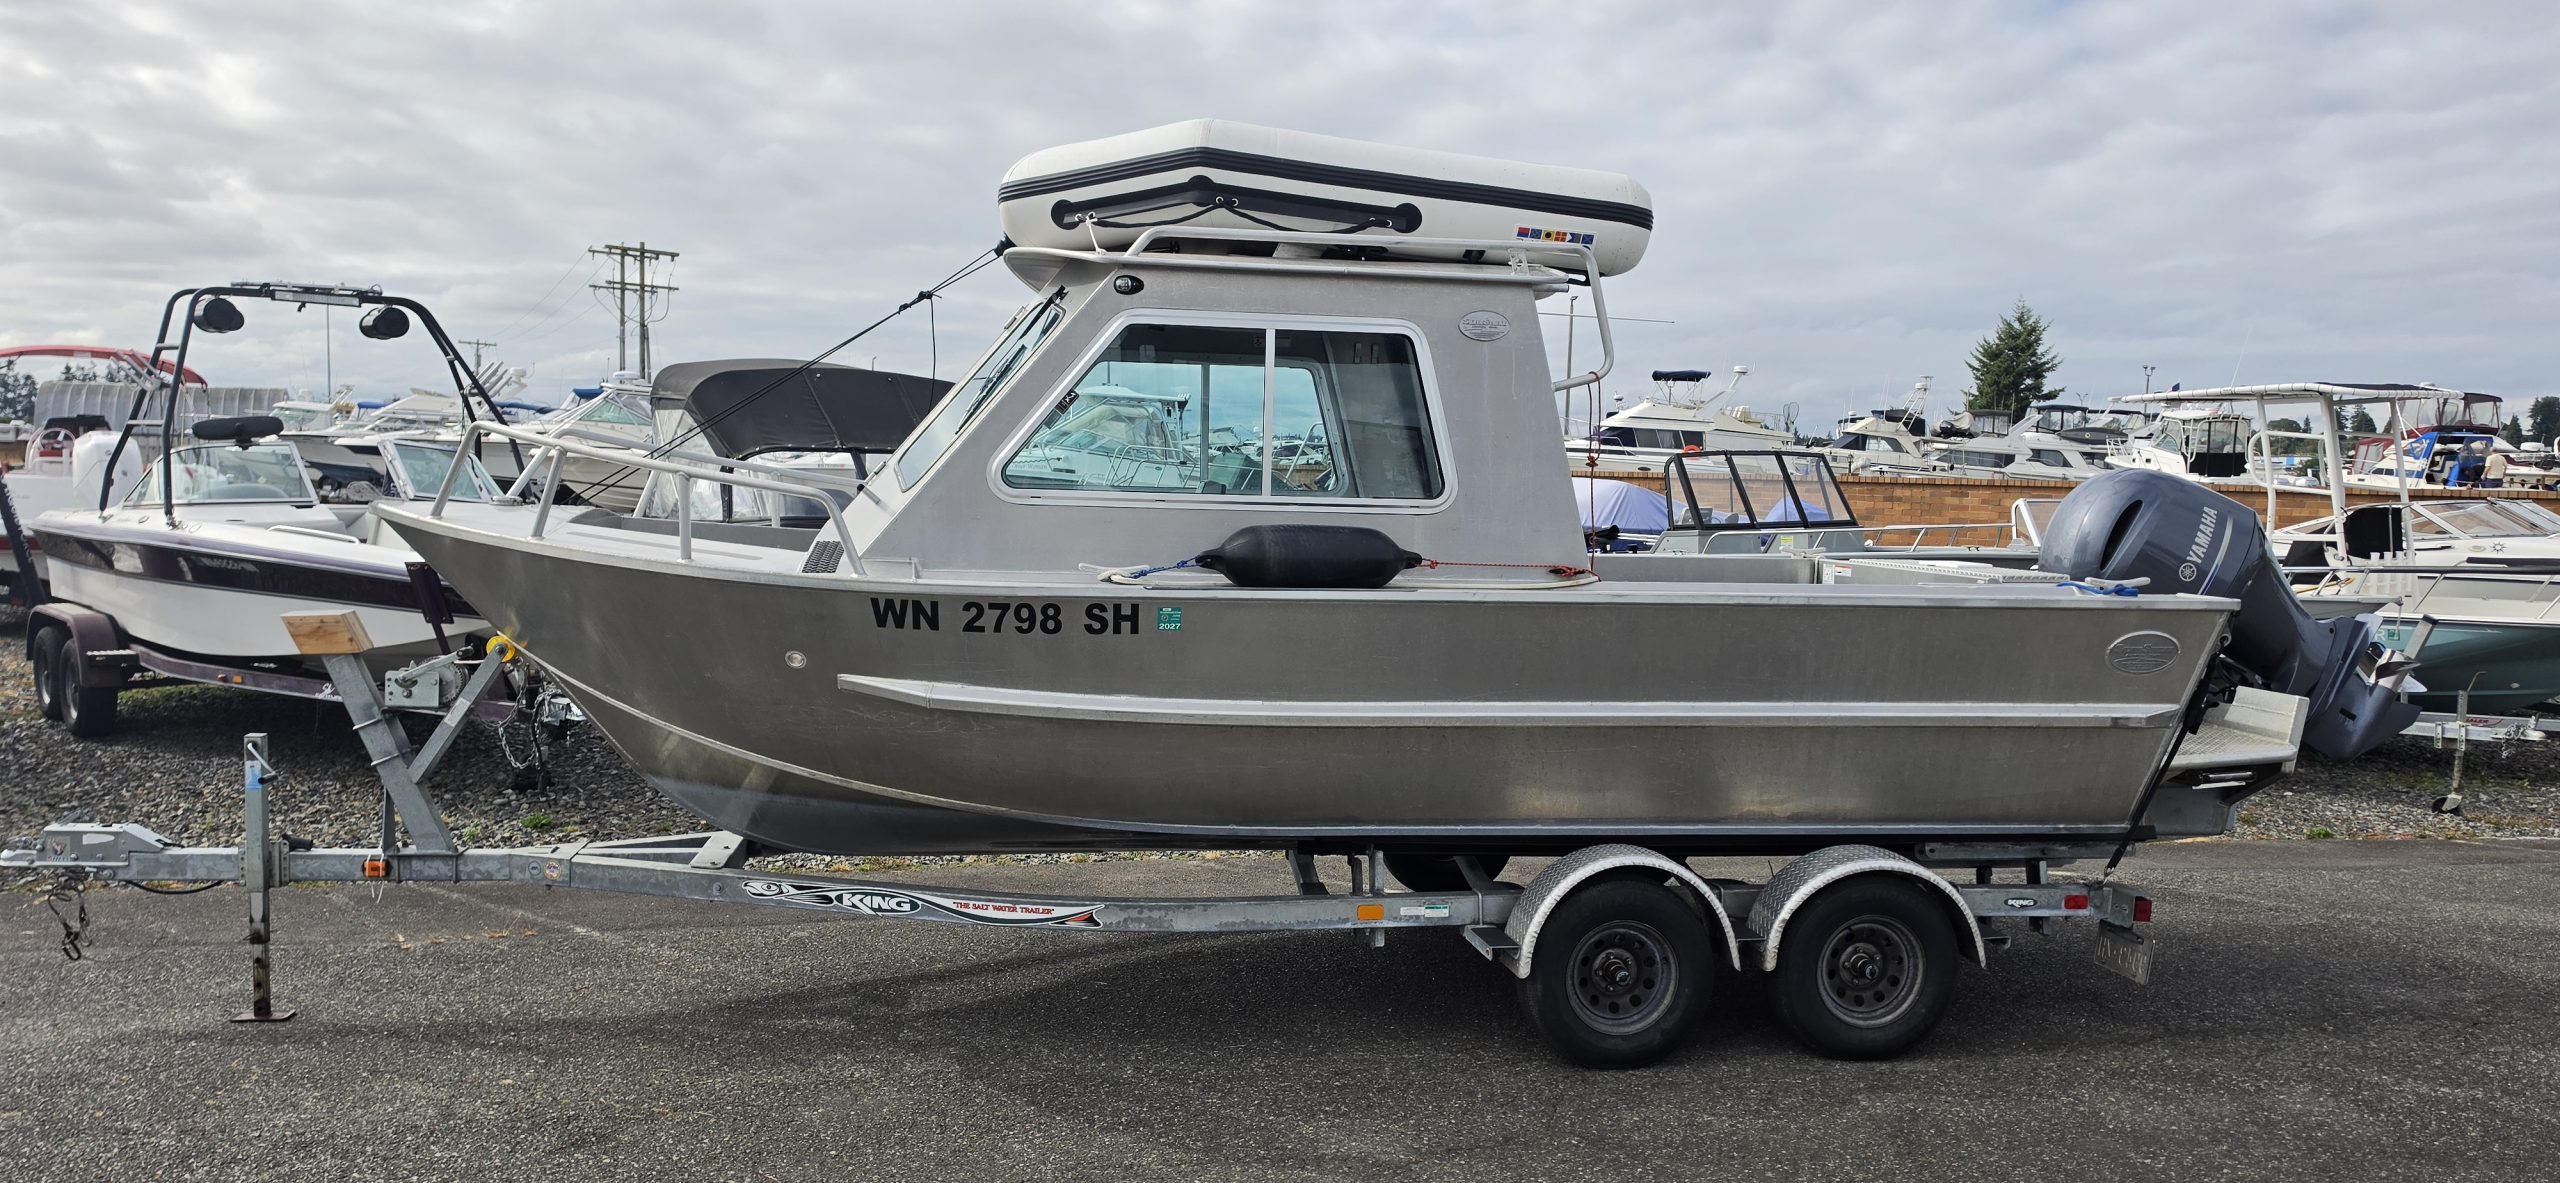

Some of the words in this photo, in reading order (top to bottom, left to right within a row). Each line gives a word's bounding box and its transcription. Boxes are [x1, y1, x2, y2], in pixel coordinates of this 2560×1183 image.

[2186, 506, 2218, 564] YAMAHA
[870, 597, 940, 631] WN
[961, 601, 1063, 635] 2798
[1083, 602, 1140, 635] SH
[842, 893, 911, 916] KING
[972, 903, 990, 911] SALT
[992, 904, 1018, 913] WATER
[2007, 899, 2034, 908] KING
